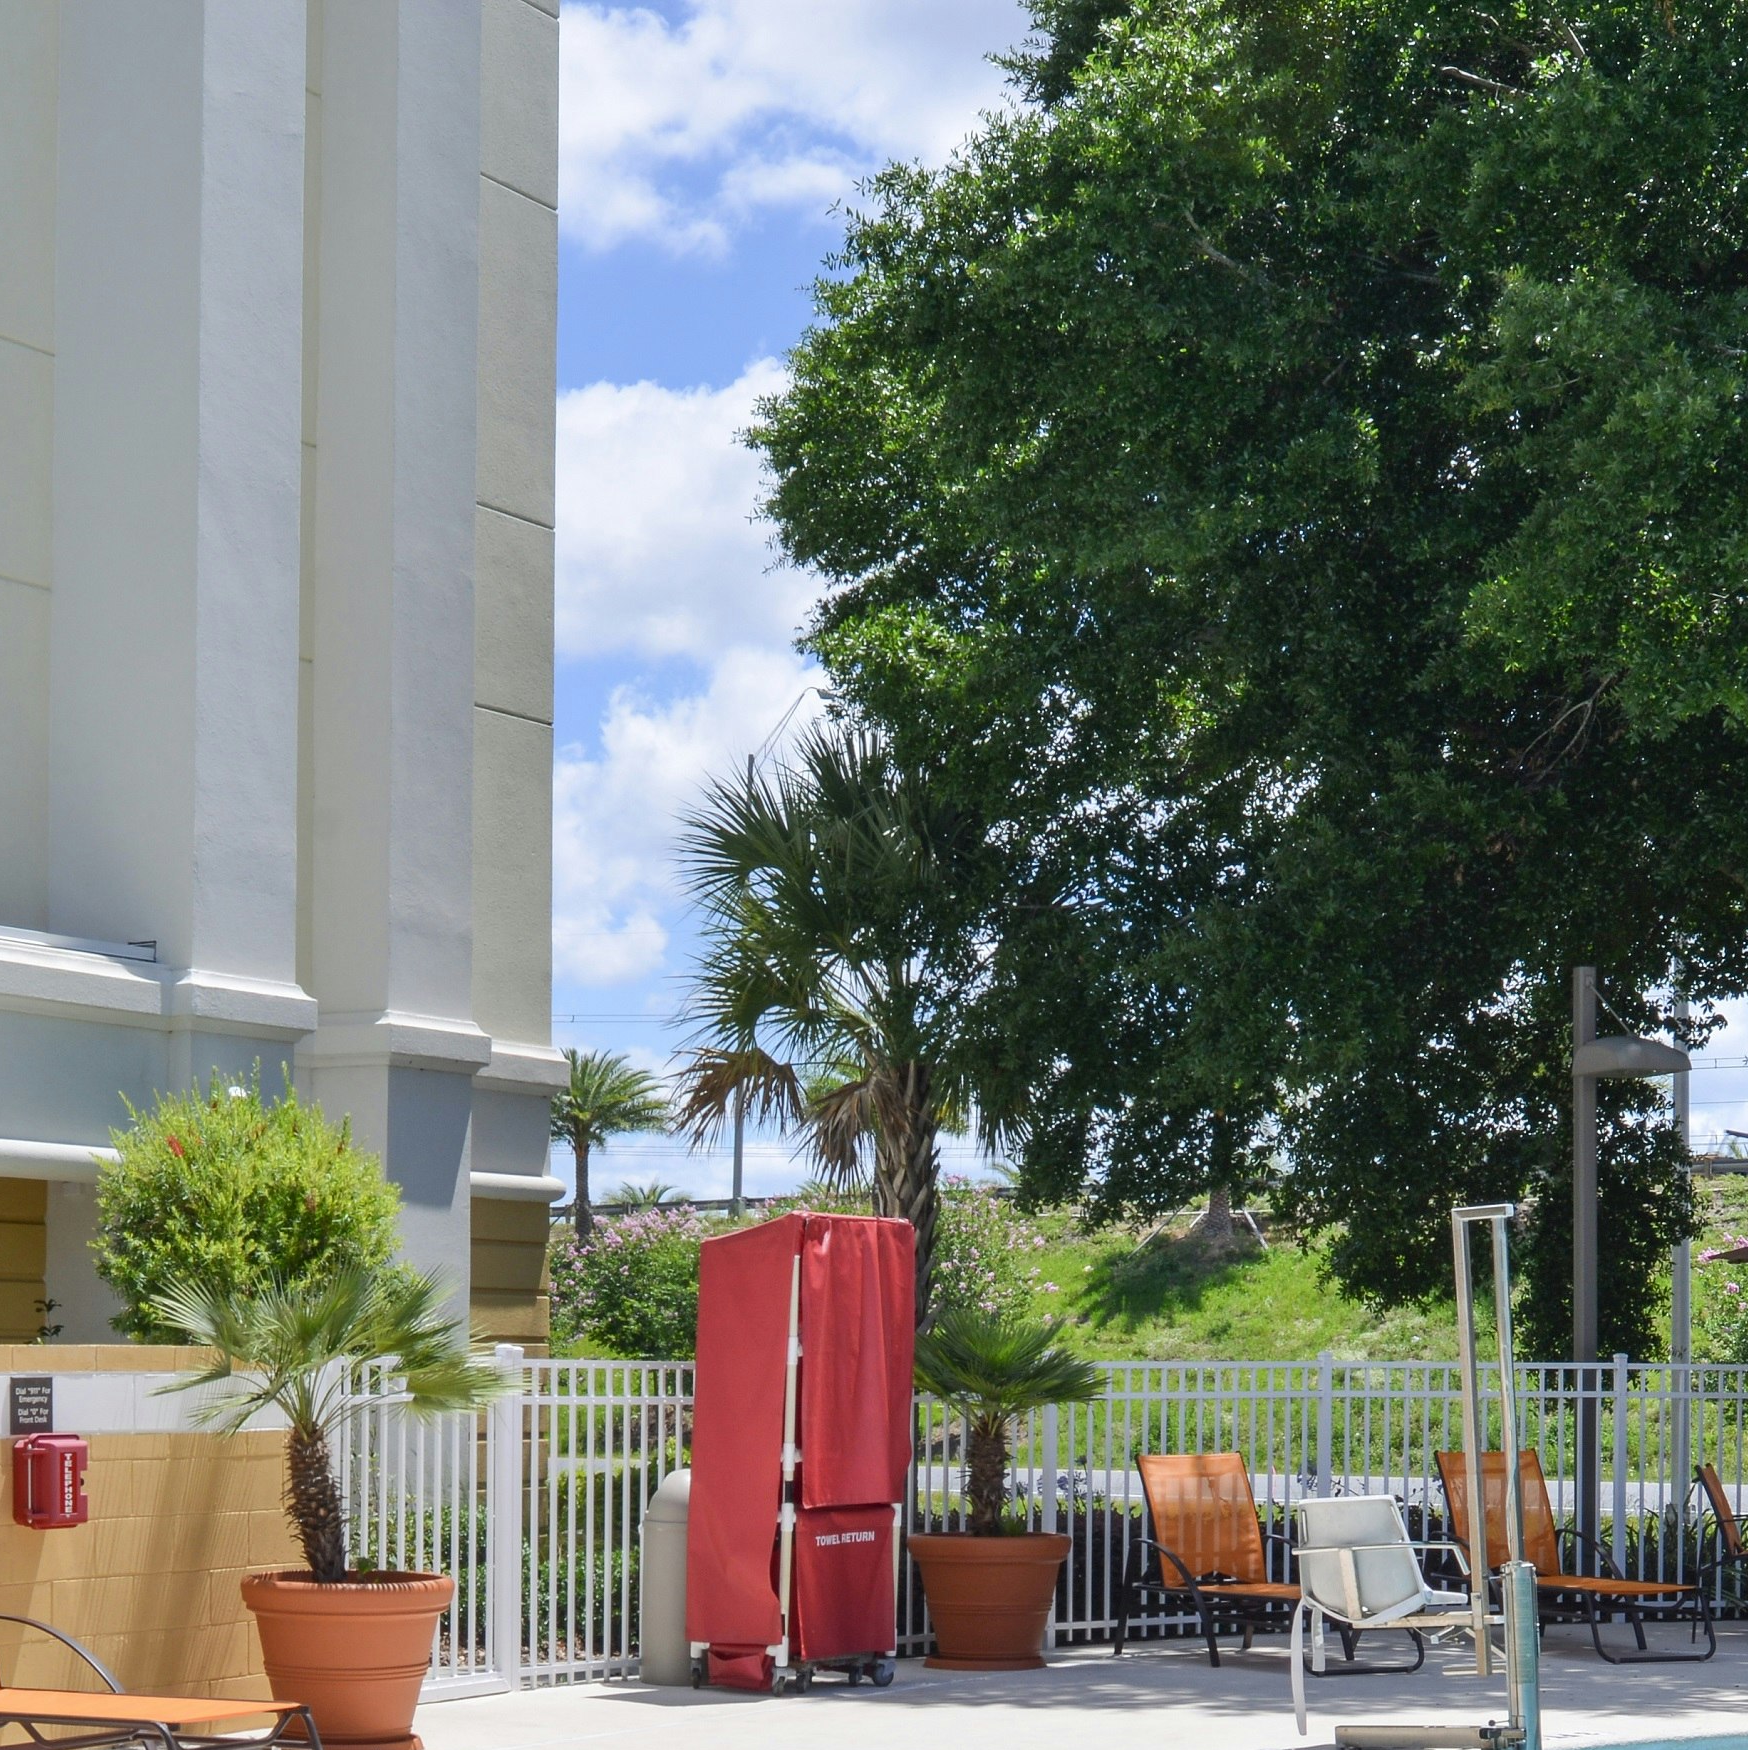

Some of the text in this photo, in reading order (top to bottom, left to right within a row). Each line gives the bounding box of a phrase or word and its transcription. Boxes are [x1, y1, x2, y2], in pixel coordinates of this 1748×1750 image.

[64, 1453, 73, 1514] TELEPHONE
[815, 1531, 875, 1546] TOWEL RETURN
